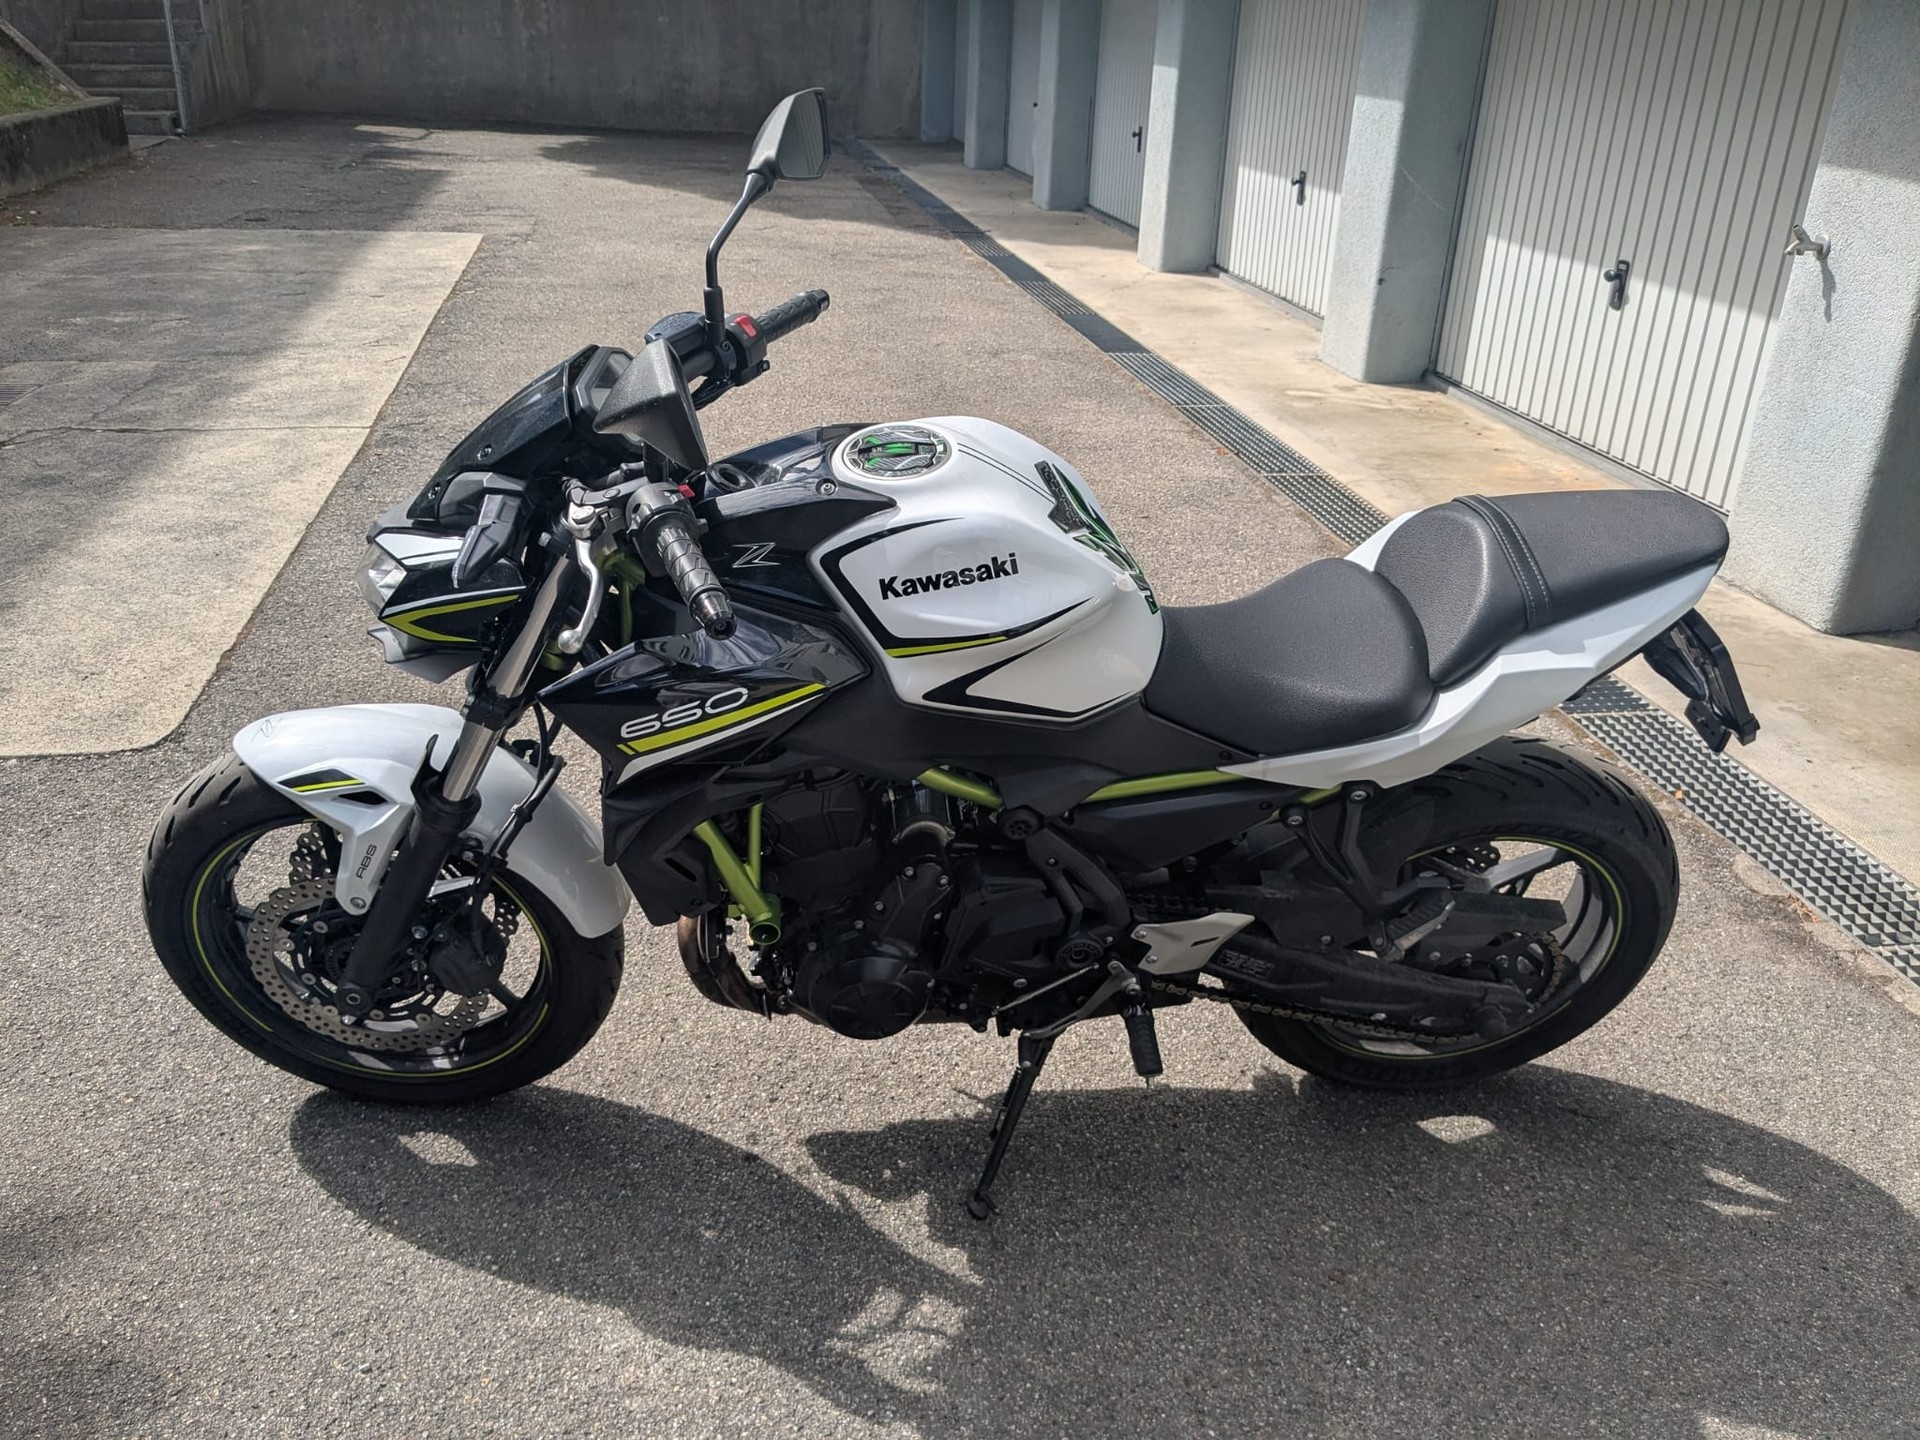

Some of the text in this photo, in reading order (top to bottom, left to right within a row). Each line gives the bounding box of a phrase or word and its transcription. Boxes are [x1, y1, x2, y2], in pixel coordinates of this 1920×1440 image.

[878, 552, 1019, 600] Kawasaki
[620, 687, 748, 738] 650
[356, 844, 377, 879] ABS
